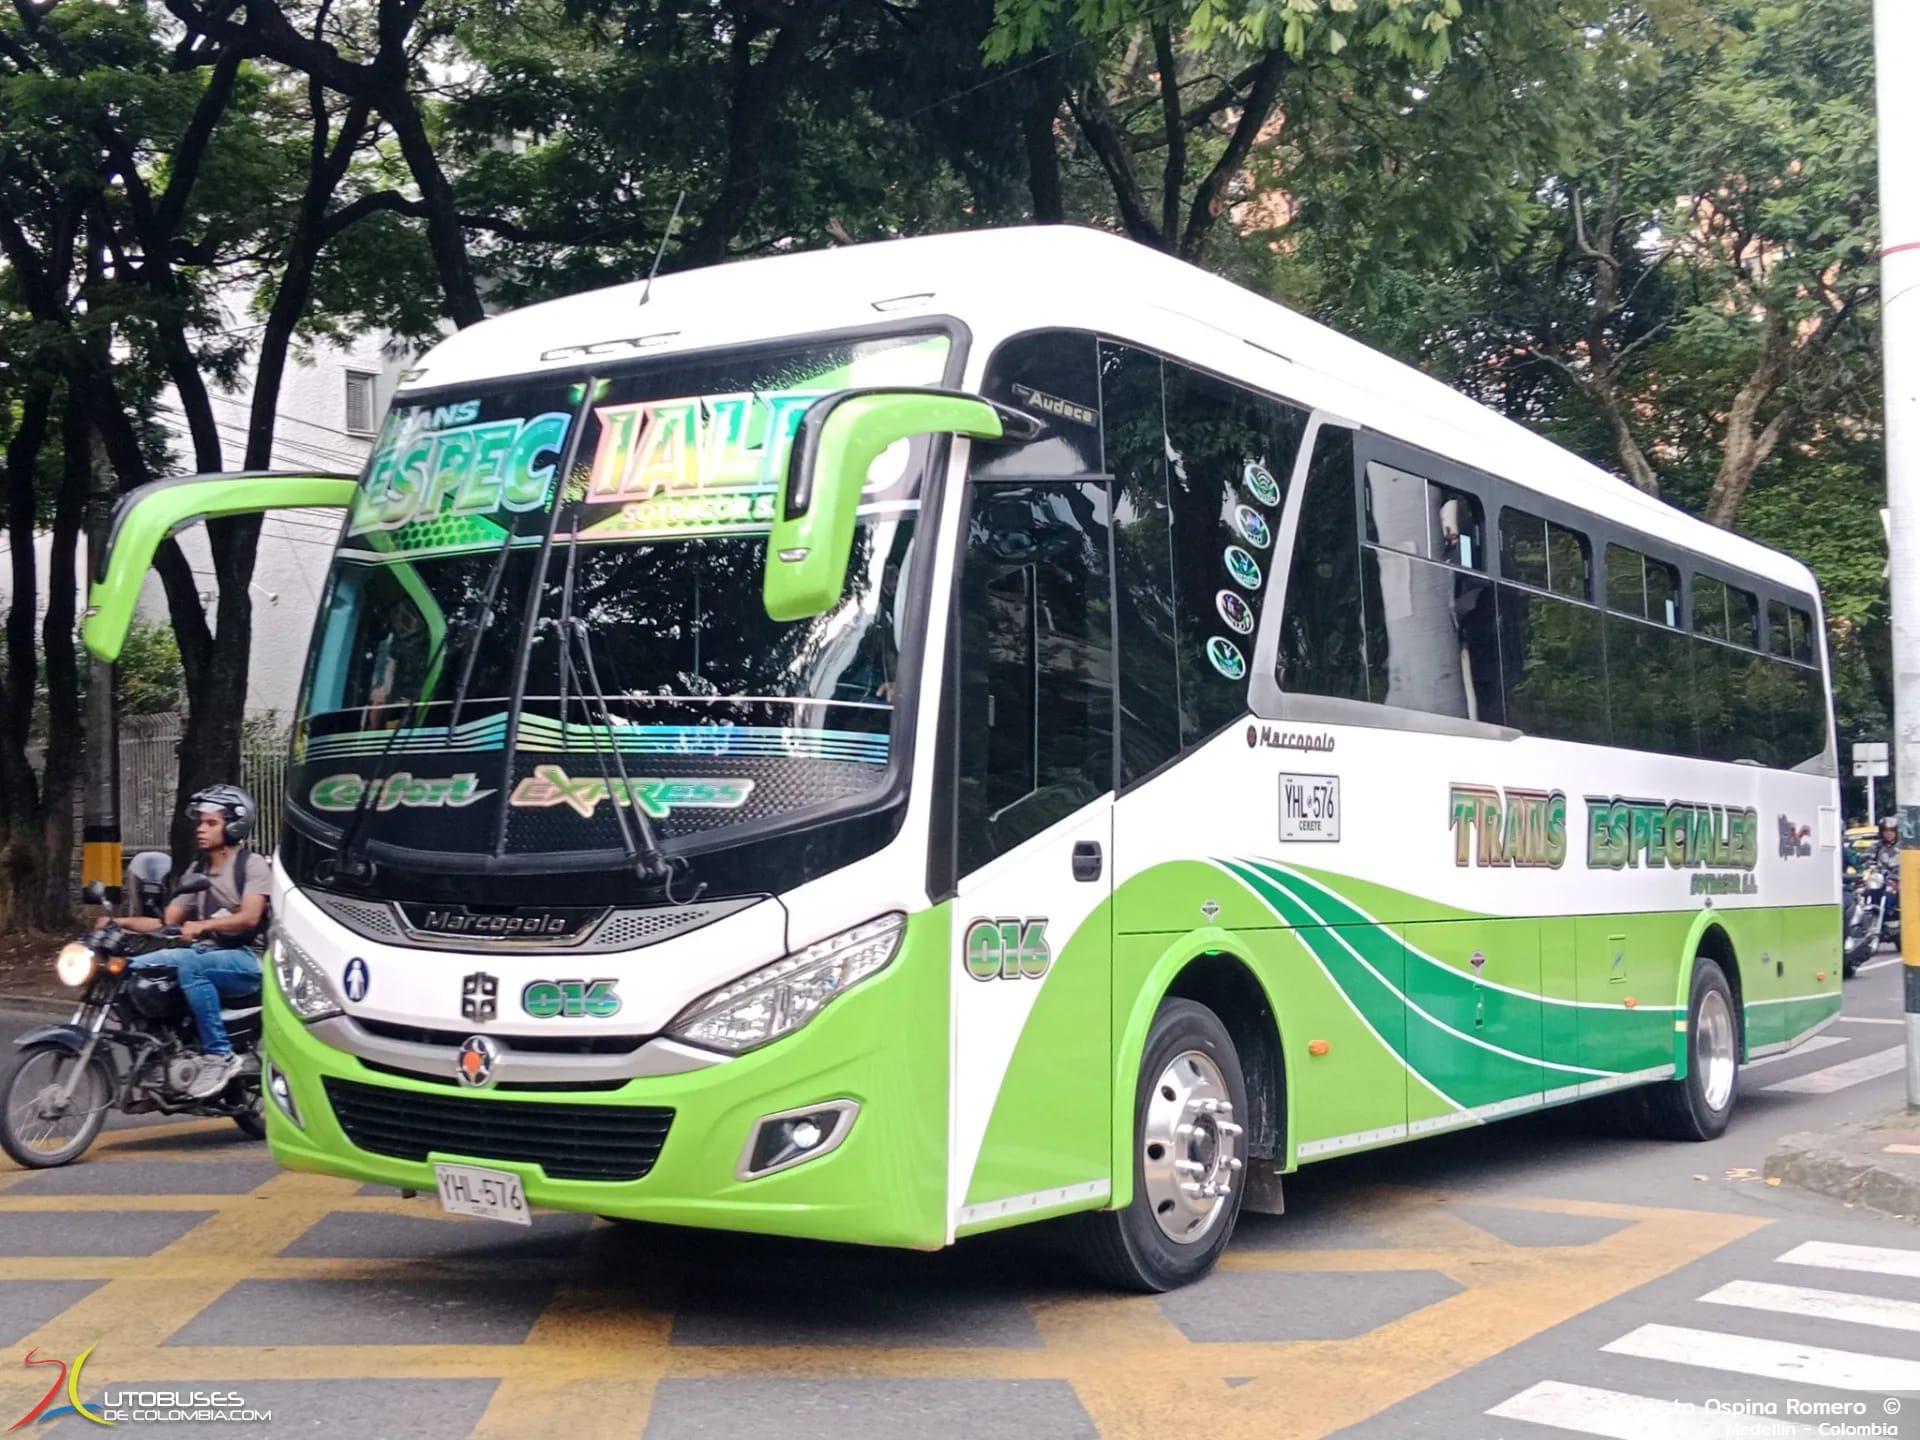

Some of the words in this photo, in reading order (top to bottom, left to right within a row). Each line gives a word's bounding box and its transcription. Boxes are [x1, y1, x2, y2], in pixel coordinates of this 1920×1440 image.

[1259, 725, 1335, 753] Marcopolo
[1449, 782, 1567, 869] TRANS
[1583, 794, 1757, 872] ESPECIALES
[423, 911, 566, 935] Marcopolo
[963, 916, 1052, 983] 016
[521, 978, 623, 1019] 016
